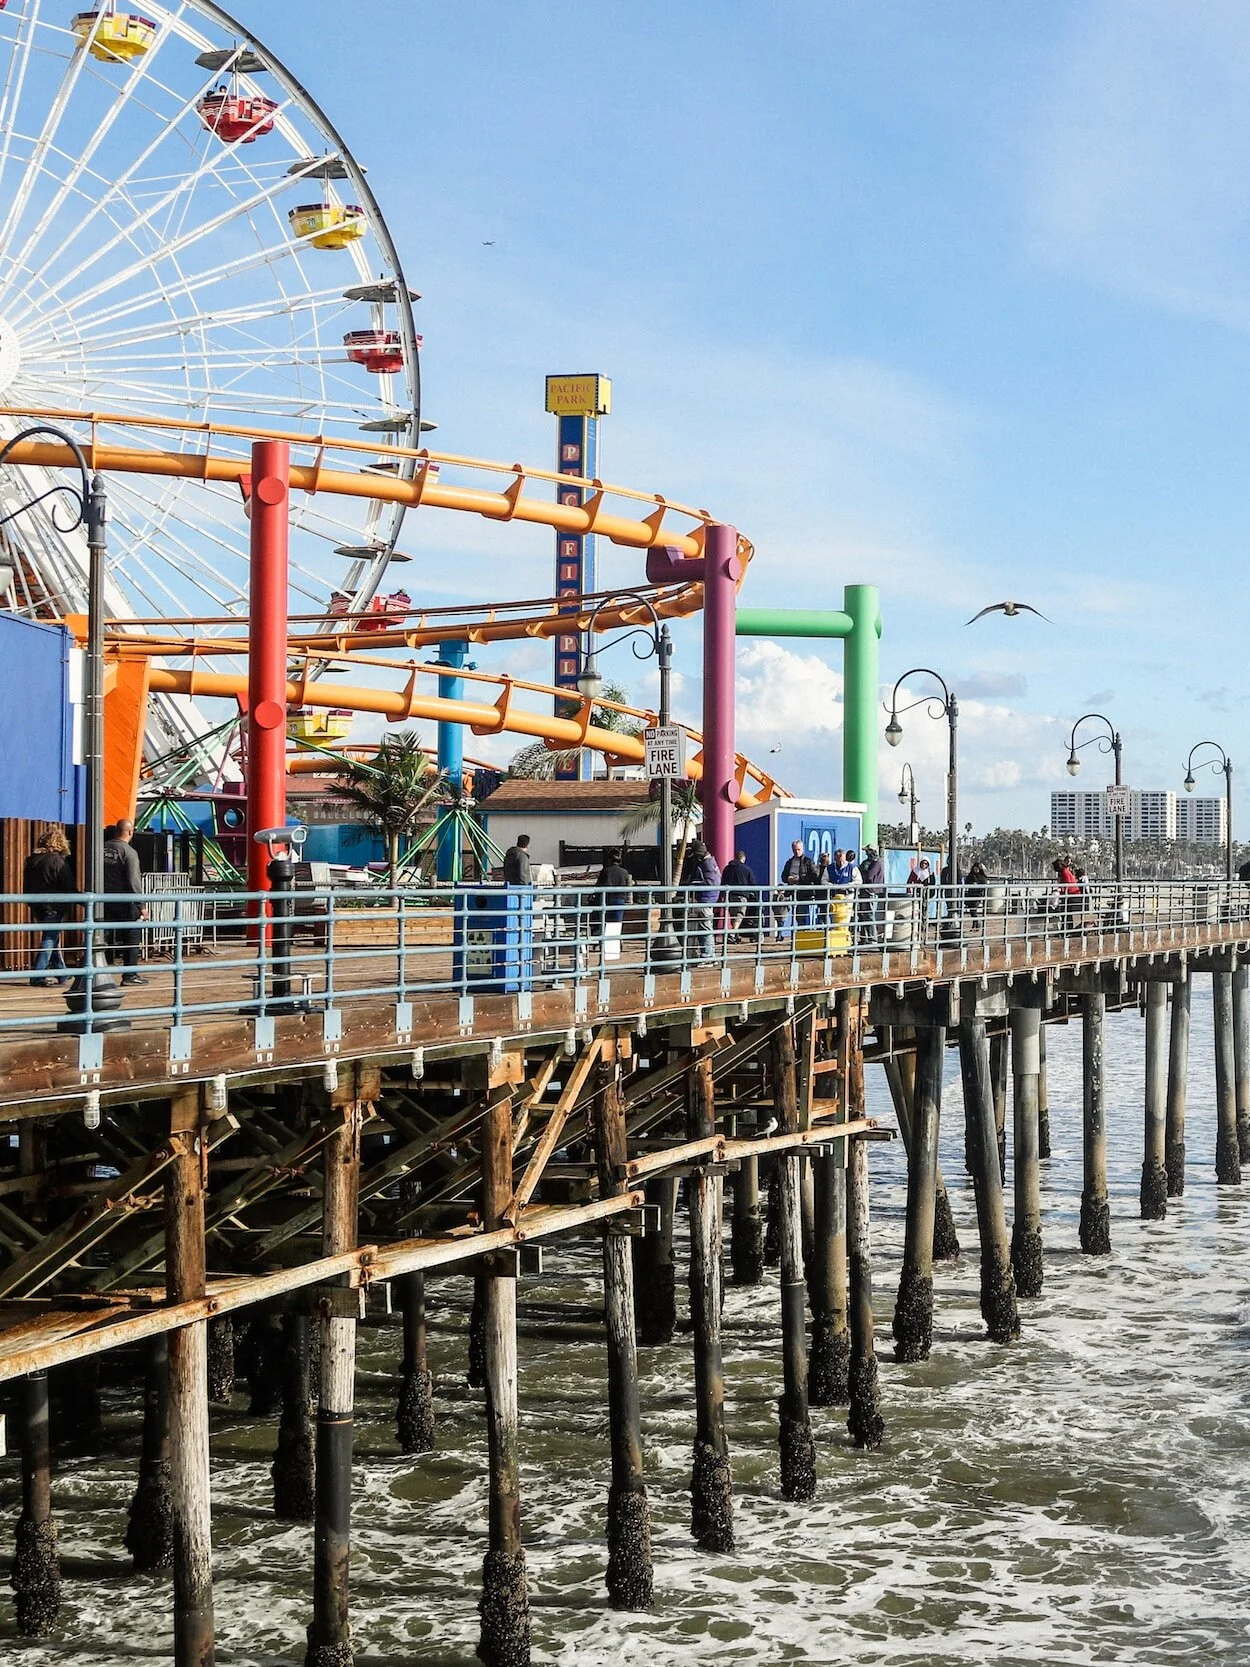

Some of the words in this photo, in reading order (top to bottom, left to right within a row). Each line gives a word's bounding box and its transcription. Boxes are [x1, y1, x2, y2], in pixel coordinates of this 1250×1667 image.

[551, 384, 591, 393] PACIFIC
[557, 395, 586, 404] PARK
[645, 730, 655, 739] NO
[651, 749, 675, 761] FIRE
[649, 762, 678, 776] LANE
